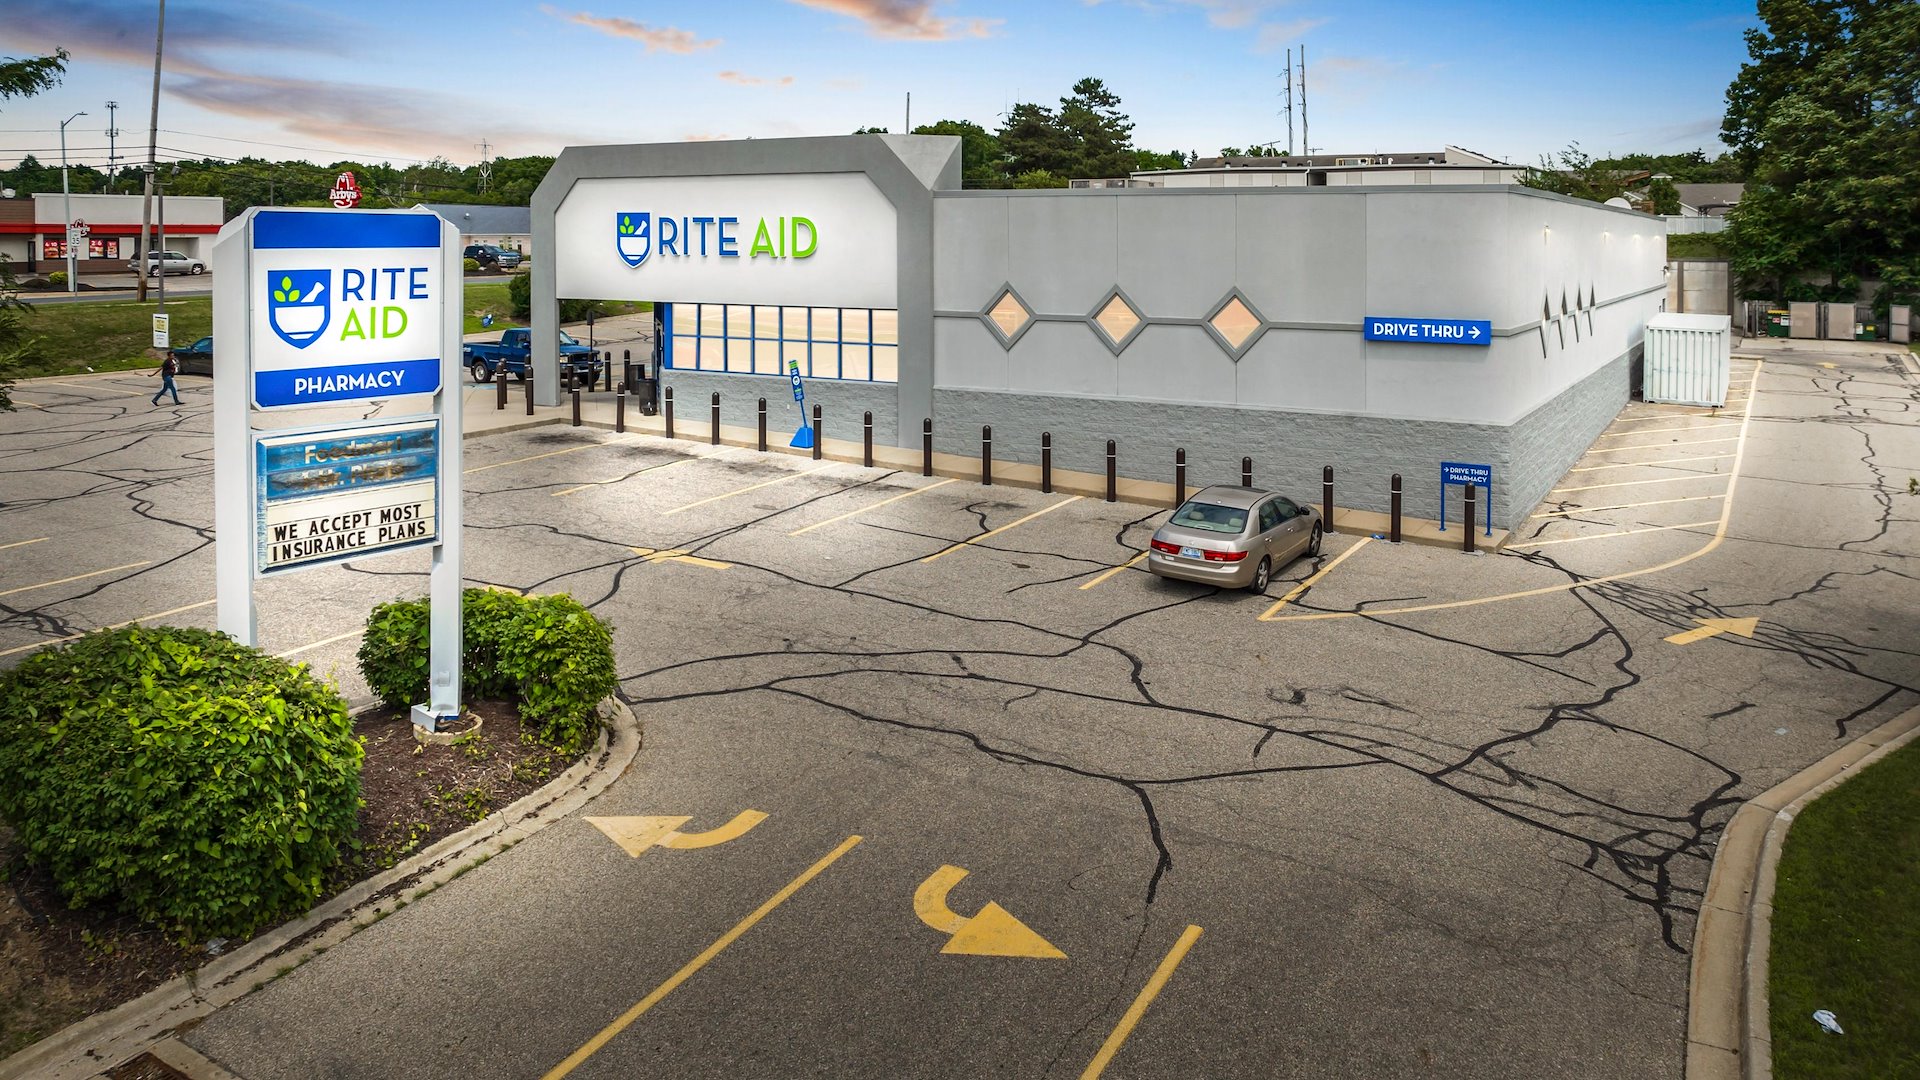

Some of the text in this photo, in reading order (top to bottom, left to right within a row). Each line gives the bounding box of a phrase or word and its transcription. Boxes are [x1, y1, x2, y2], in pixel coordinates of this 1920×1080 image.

[658, 216, 819, 258] RITE AID
[342, 267, 429, 302] RITE
[340, 306, 408, 341] AID
[1373, 322, 1464, 338] DRIVE THRU
[294, 370, 405, 396] PHARMACY
[1450, 467, 1489, 476] DRIVE THRU
[1450, 474, 1487, 483] PHARMACY
[274, 504, 422, 542] WE ACCEPT MOST
[273, 521, 426, 562] INSURANCE PLANS
